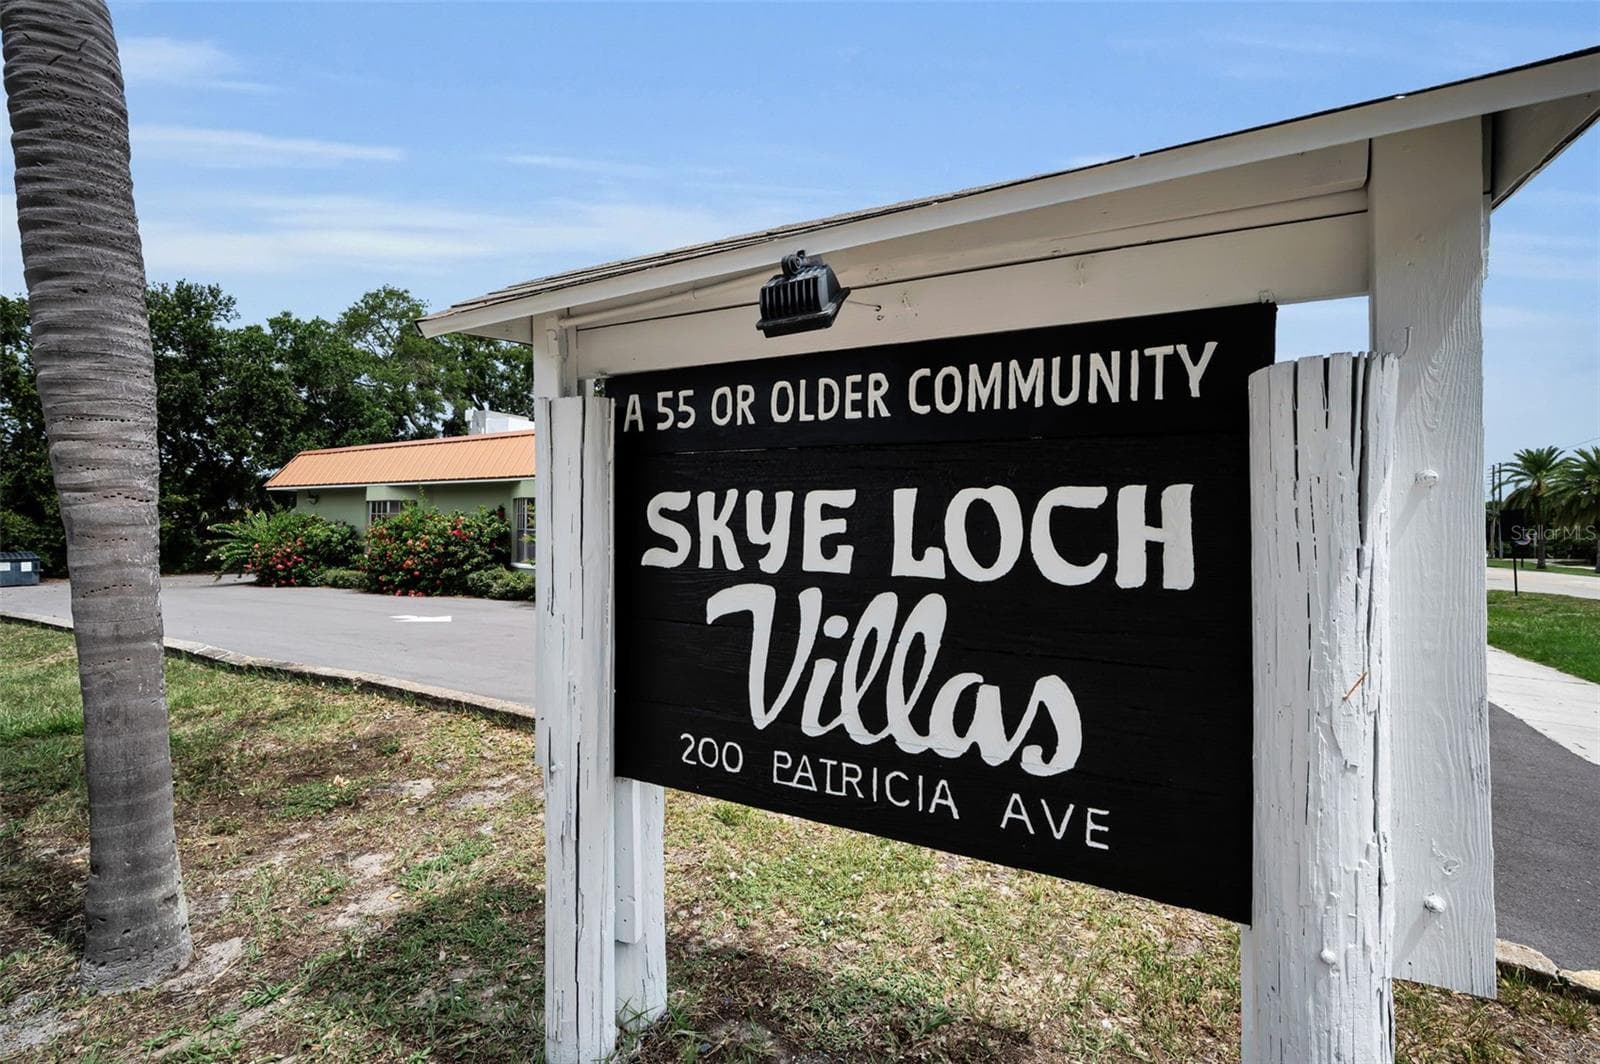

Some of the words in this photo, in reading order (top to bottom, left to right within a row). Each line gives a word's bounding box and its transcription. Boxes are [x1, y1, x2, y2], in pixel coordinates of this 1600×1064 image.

[623, 394, 645, 433] A
[656, 389, 697, 430] 55
[711, 384, 756, 426] OR
[770, 372, 891, 423] OLDER
[908, 341, 1218, 415] COMMUNITY
[640, 488, 857, 575] SKYE
[892, 483, 1195, 591] LOCH
[706, 583, 1083, 777] Villas
[680, 733, 744, 773] 200
[773, 750, 960, 820] PATRICIA
[1000, 793, 1110, 850] AVE
